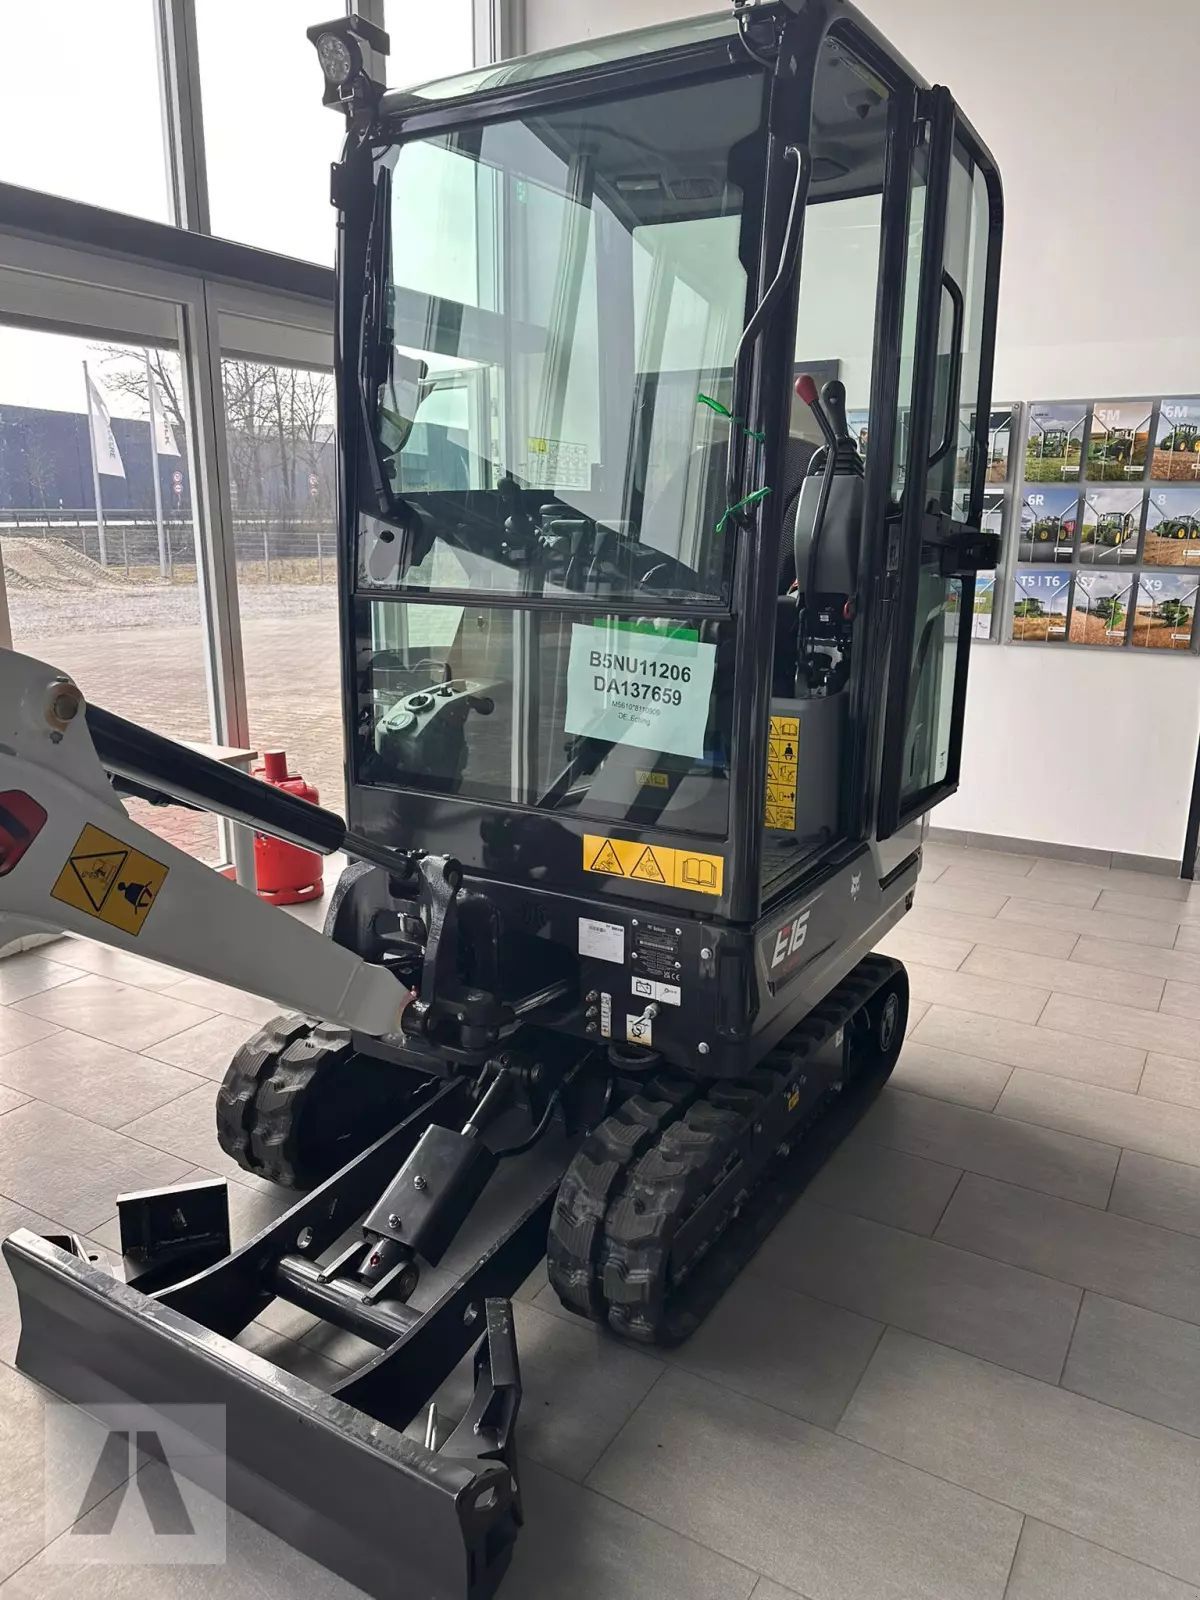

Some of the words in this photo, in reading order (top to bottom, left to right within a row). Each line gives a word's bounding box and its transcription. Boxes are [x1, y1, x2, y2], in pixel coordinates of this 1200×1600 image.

[1099, 409, 1121, 421] 5M
[1165, 405, 1189, 418] 6M
[1027, 494, 1045, 506] 6R
[1090, 494, 1098, 505] 7
[1158, 493, 1166, 505] 8
[1020, 575, 1035, 587] T5
[1044, 576, 1060, 587] T6
[1080, 577, 1097, 588] S7
[1144, 579, 1163, 591] X9
[589, 650, 692, 683] B5NU11206
[594, 675, 682, 706] DA137659
[771, 910, 810, 969] E16
